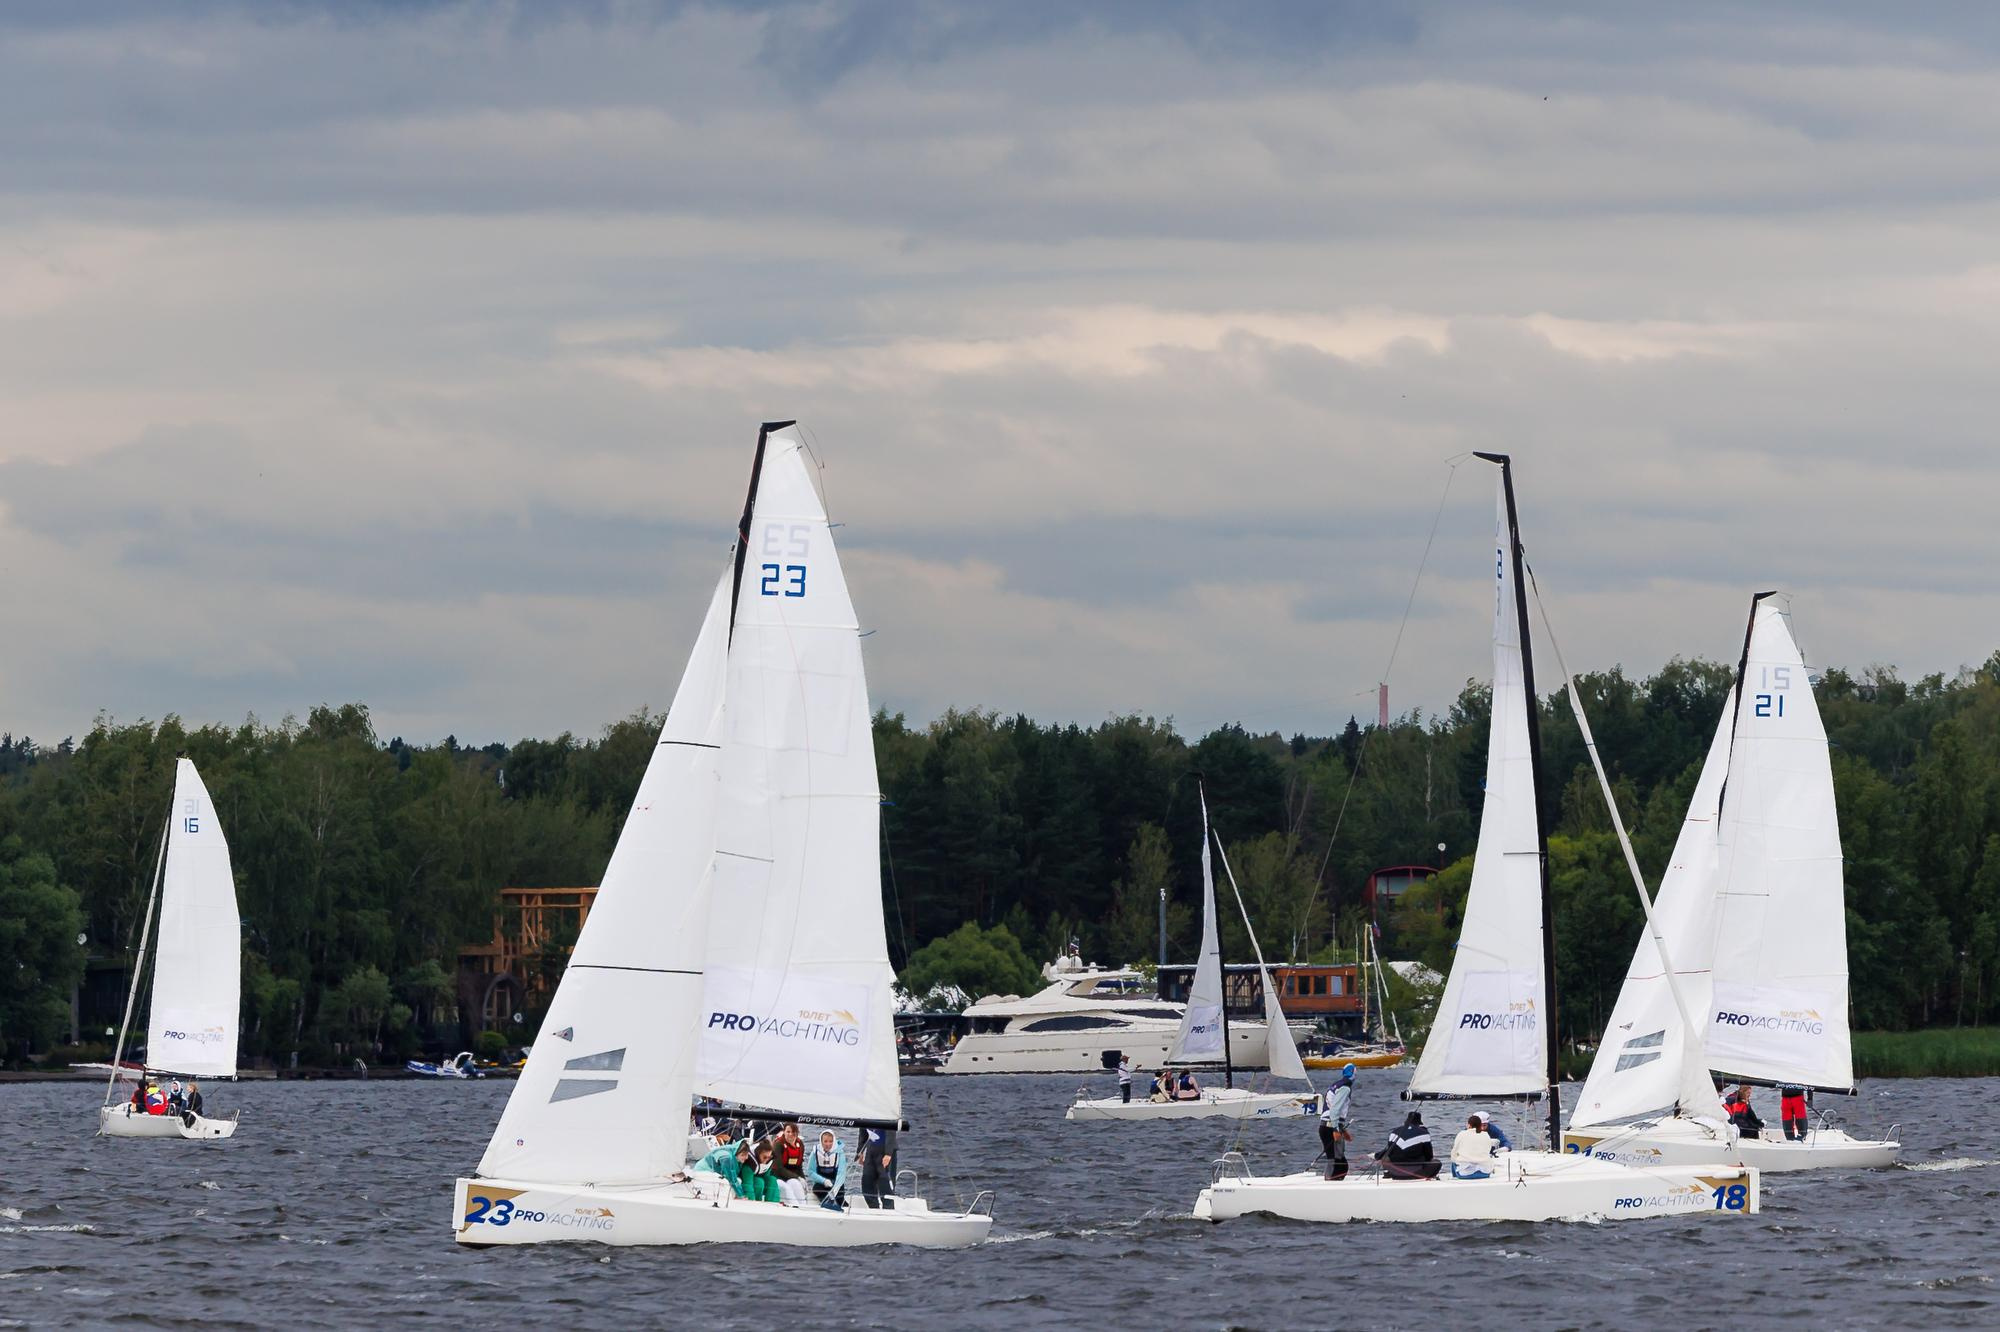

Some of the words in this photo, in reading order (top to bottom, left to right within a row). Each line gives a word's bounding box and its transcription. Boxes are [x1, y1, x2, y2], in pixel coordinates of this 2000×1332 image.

[762, 564, 807, 598] 23
[1755, 694, 1784, 718] 21
[184, 817, 199, 833] 16
[708, 1012, 859, 1046] PROYACHTING
[1460, 1013, 1536, 1030] PROYACHTING
[1715, 1011, 1823, 1036] PROYACHTING
[1302, 1102, 1318, 1115] 19
[1614, 1194, 1705, 1209] PROYACHTING
[1712, 1184, 1748, 1210] 18
[465, 1196, 514, 1227] 23
[513, 1209, 616, 1231] PROYACHTING
